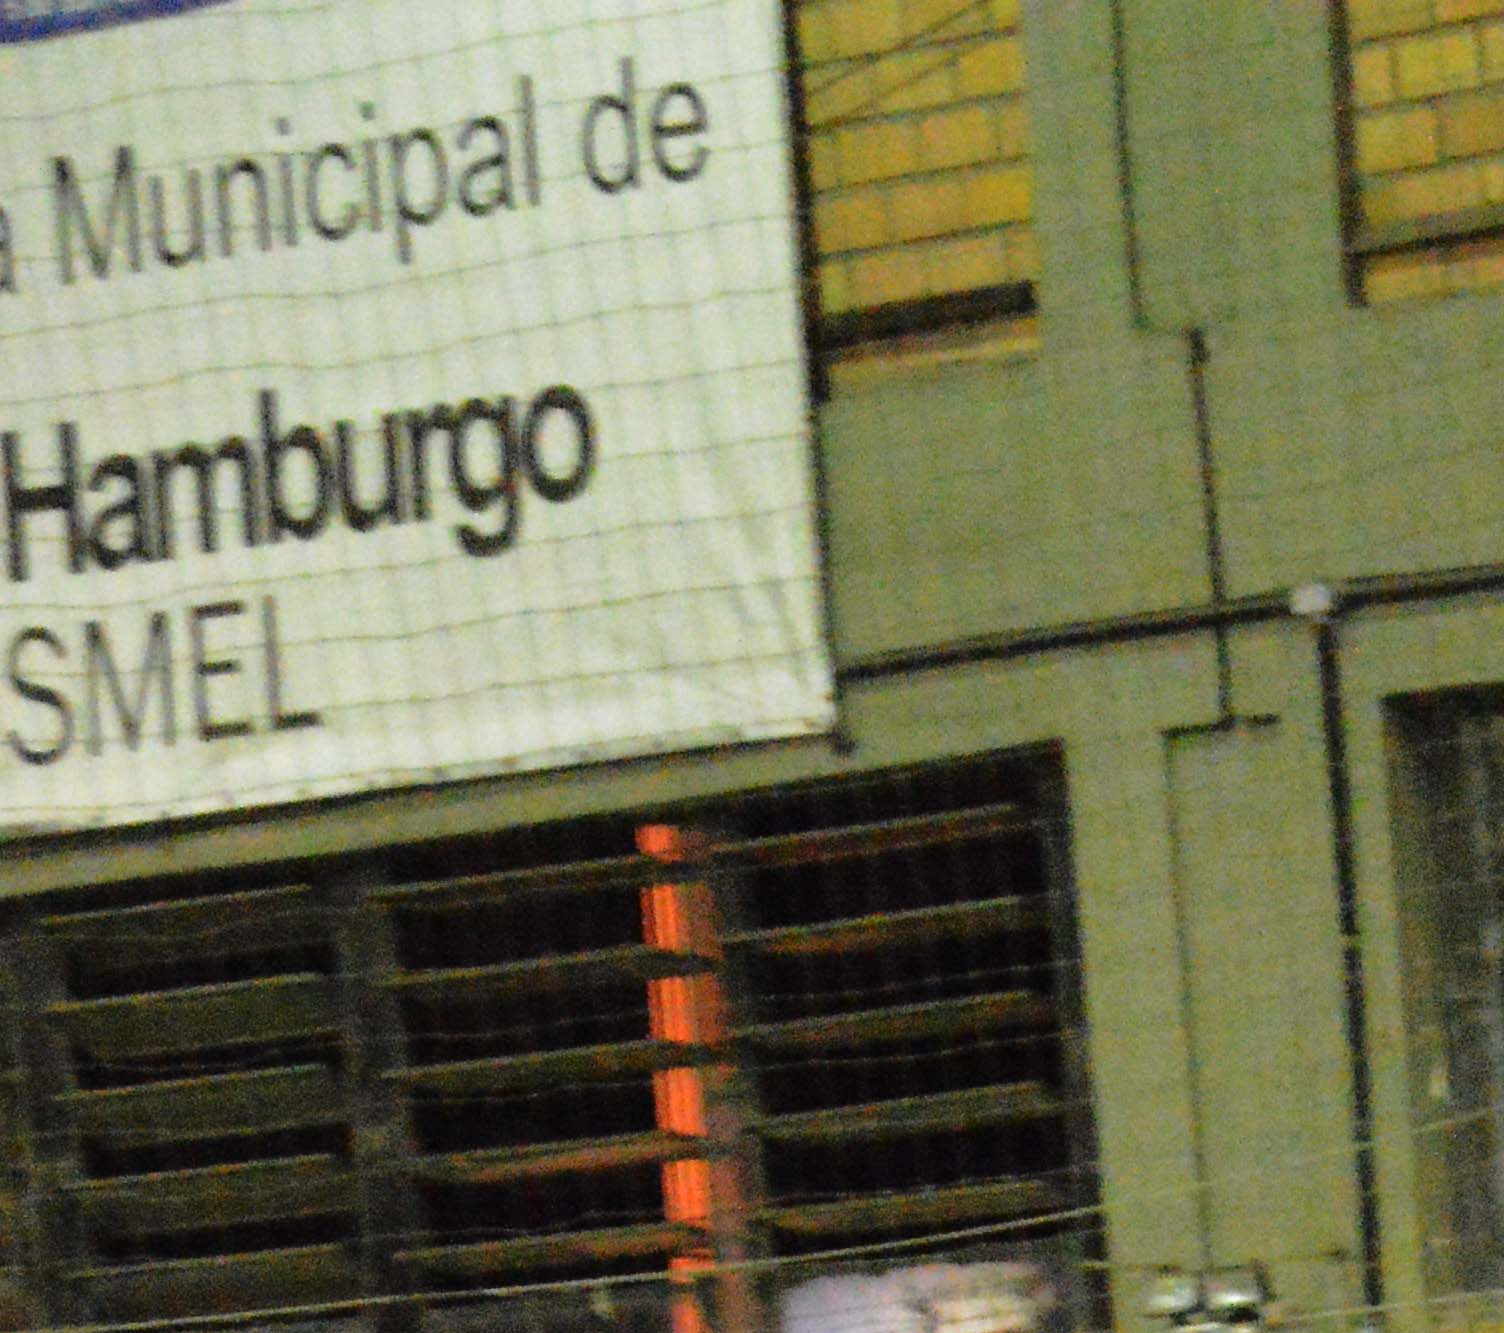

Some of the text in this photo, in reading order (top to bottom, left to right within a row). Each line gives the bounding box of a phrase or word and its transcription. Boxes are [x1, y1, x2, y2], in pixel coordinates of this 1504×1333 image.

[52, 75, 541, 286] Municipal
[582, 56, 711, 197] de
[5, 598, 323, 765] SMEL
